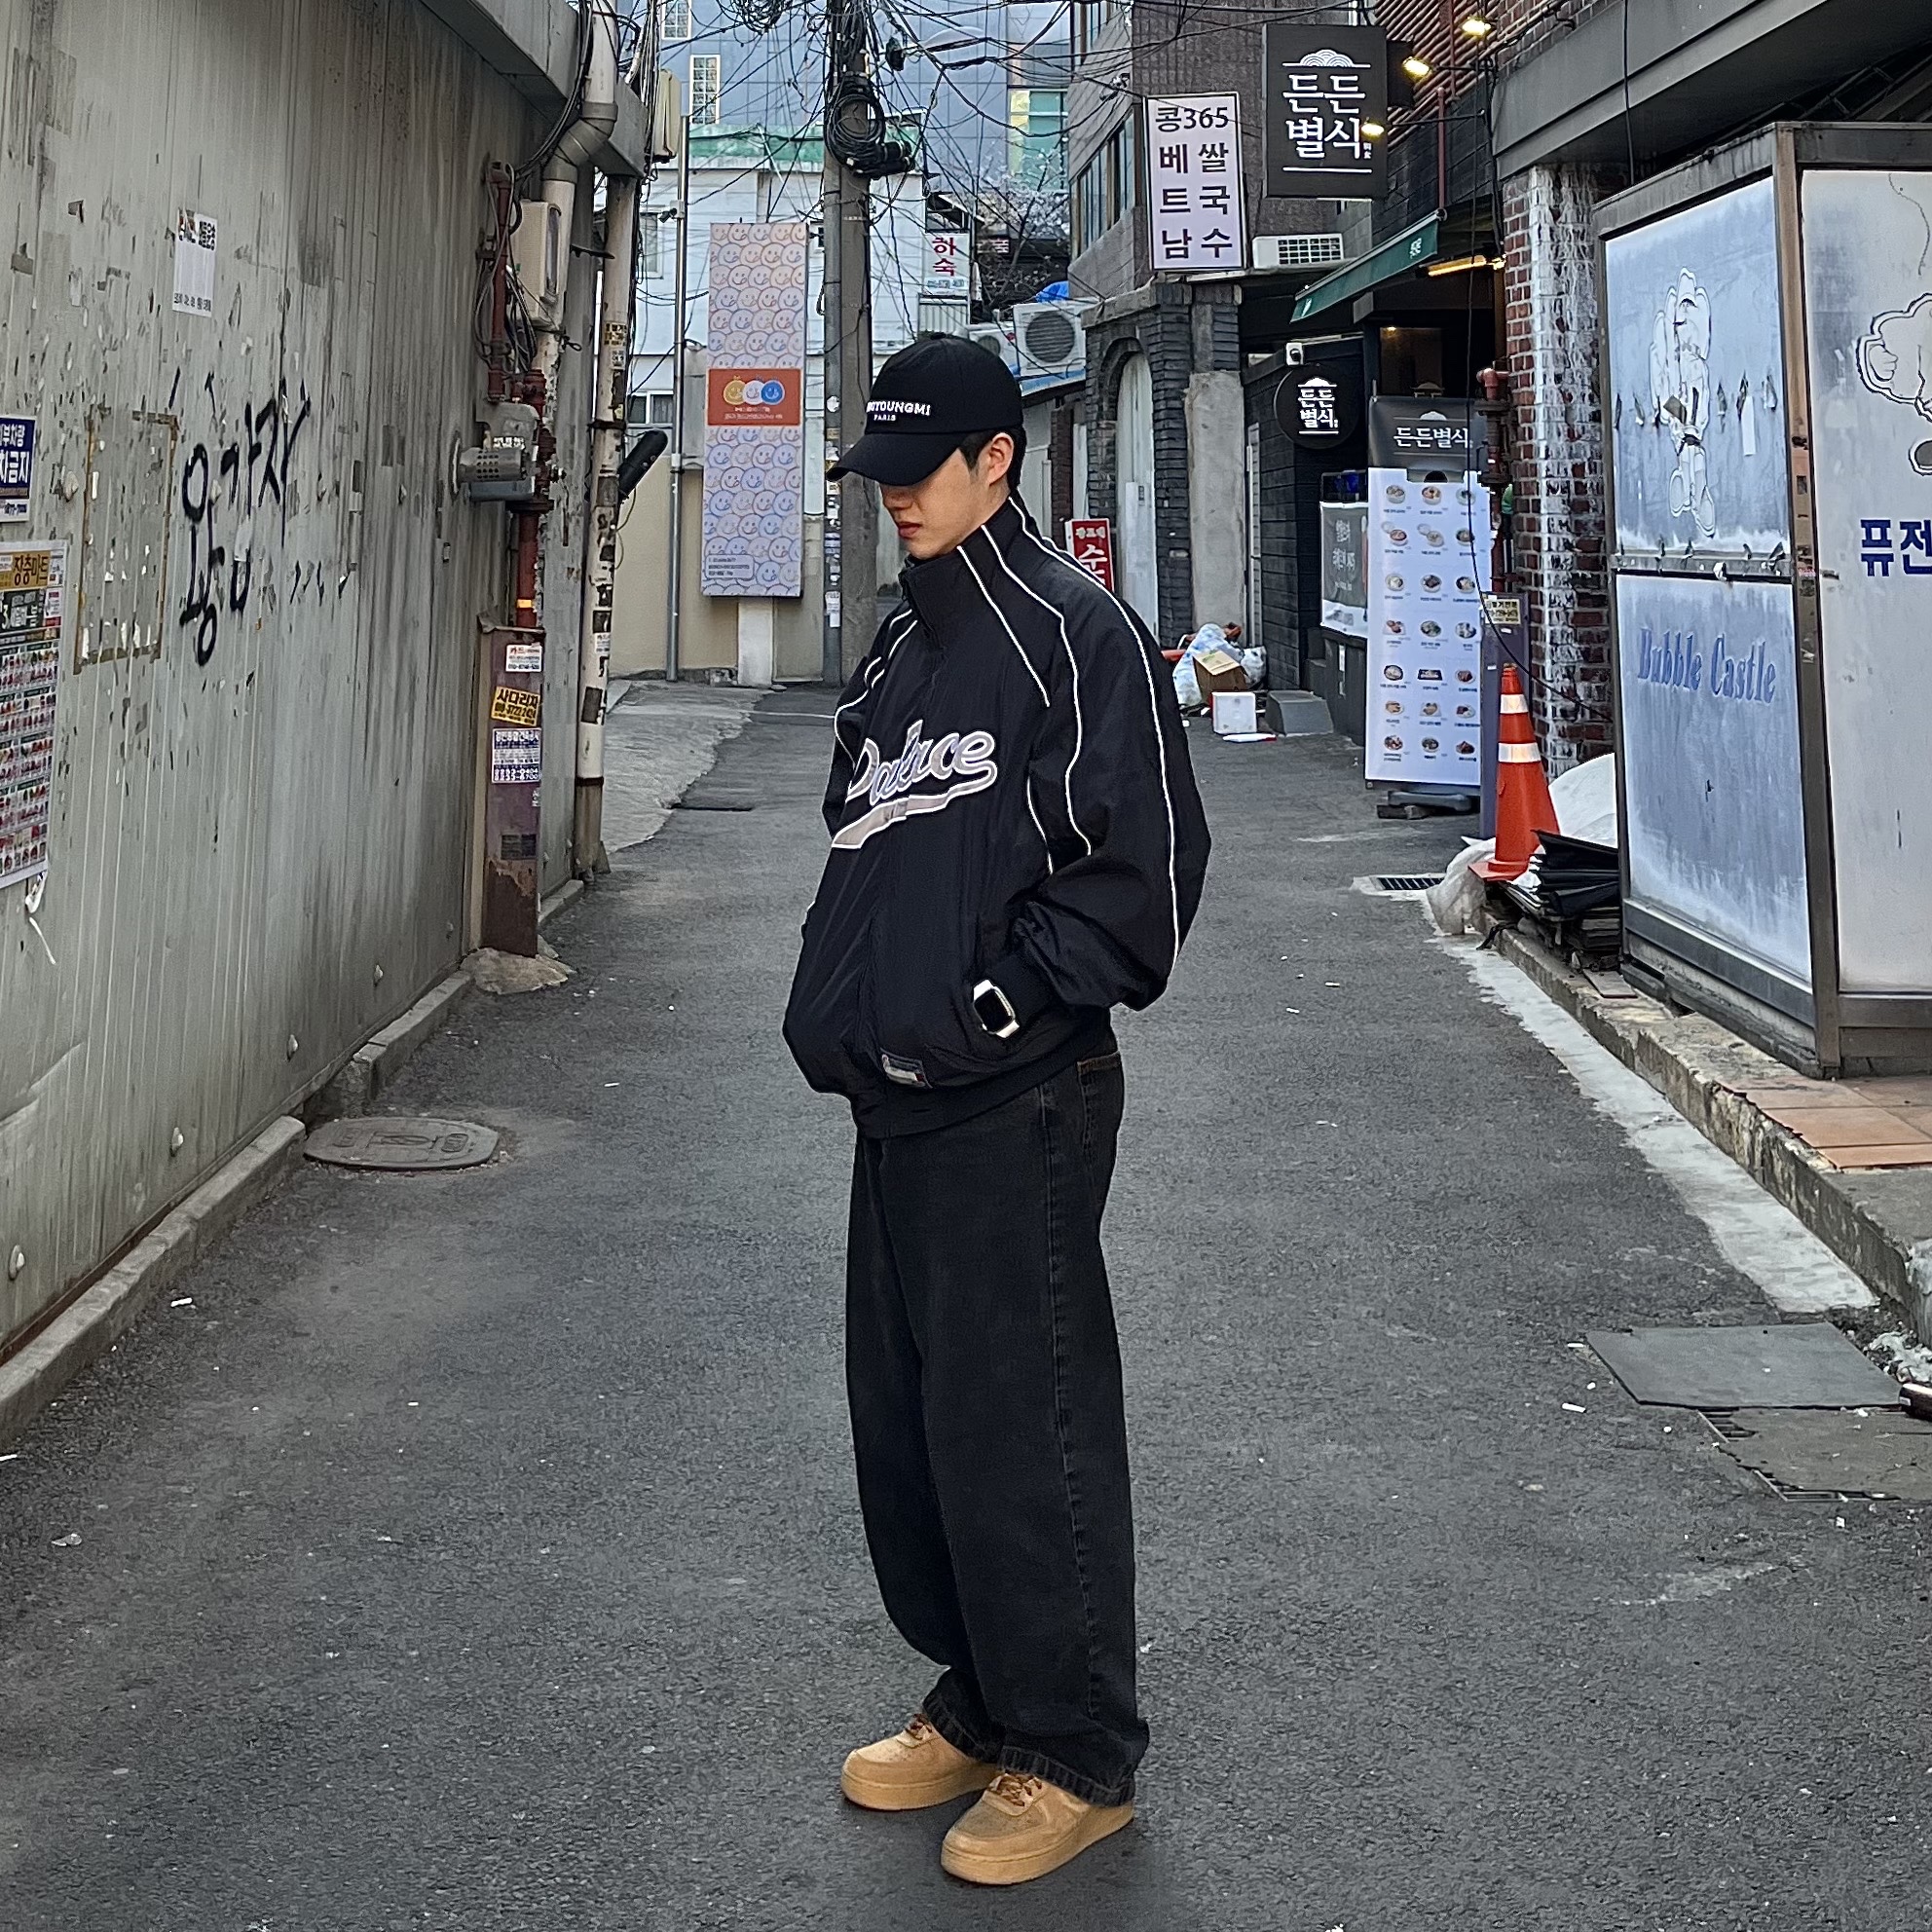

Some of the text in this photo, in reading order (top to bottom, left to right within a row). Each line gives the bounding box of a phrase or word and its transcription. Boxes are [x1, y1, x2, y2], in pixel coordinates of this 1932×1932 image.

[1282, 74, 1366, 114] 든든
[1155, 106, 1229, 133] 콩365
[1285, 116, 1361, 160] 별식
[1159, 143, 1193, 259] 베트남
[1198, 142, 1233, 259] 쌀국수
[932, 237, 957, 277] 하숙
[1298, 389, 1336, 409] 든든
[1299, 407, 1334, 429] 별식
[0, 424, 25, 448] 부차량
[1393, 427, 1469, 449] 든든별식
[1859, 519, 1932, 577] 퓨전
[14, 552, 50, 586] 장충마트
[1710, 632, 1777, 705] Castle
